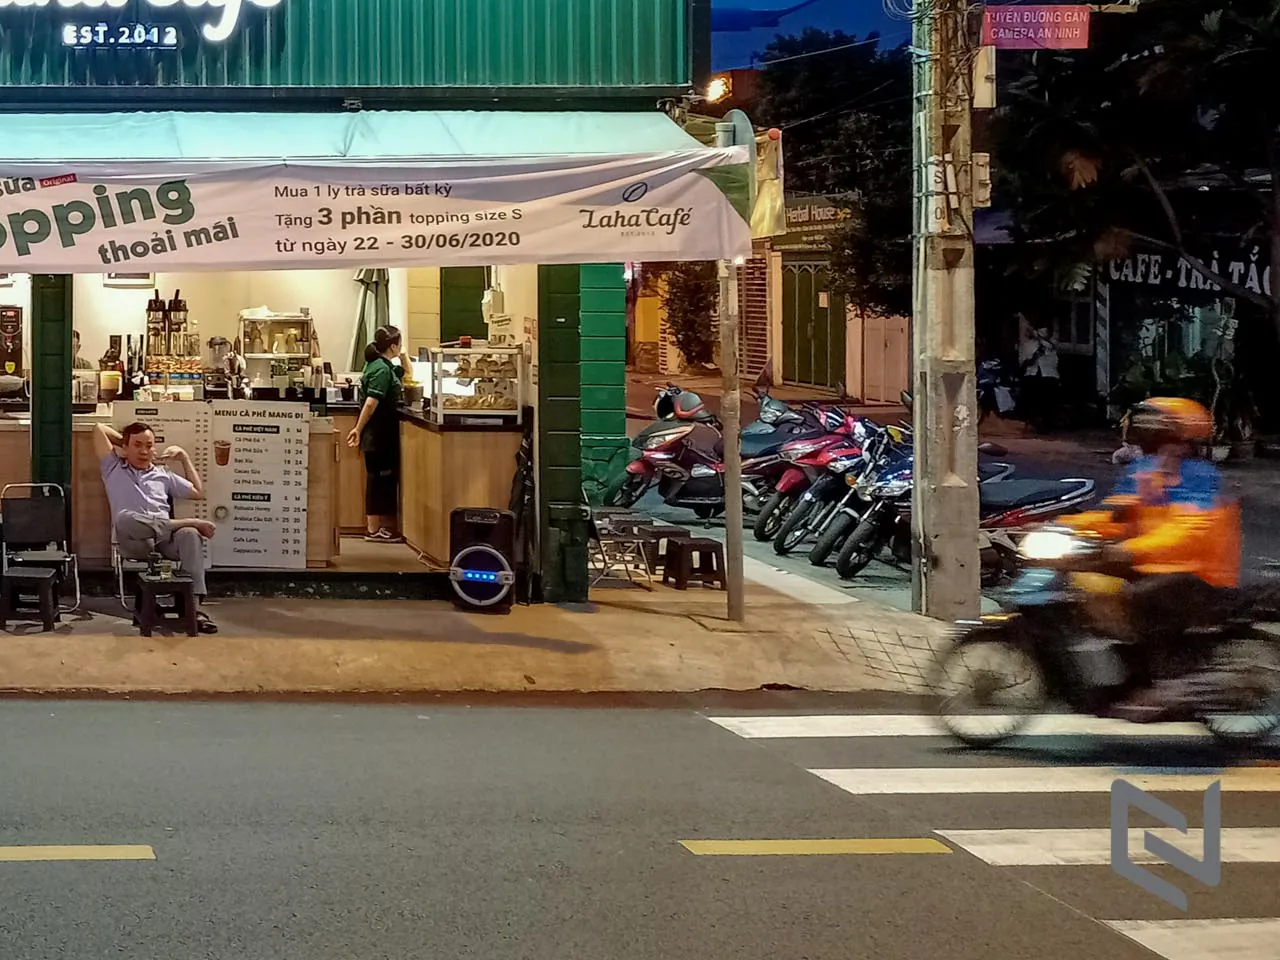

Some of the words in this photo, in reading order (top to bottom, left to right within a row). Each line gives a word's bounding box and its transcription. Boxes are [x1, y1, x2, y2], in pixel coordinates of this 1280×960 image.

[61, 23, 178, 45] EST.2012
[991, 28, 1035, 39] CAMERA
[1036, 28, 1053, 39] AN
[1054, 28, 1081, 39] NINH
[43, 175, 75, 187] Original
[274, 185, 308, 198] Mua
[314, 185, 321, 197] 1
[327, 184, 340, 199] ly
[345, 184, 366, 197] trà
[370, 183, 400, 196] sữa
[404, 183, 431, 196] bất
[434, 183, 452, 198] kỳ
[275, 214, 312, 229] Tặng
[317, 208, 333, 225] 3
[341, 205, 402, 229] phần
[409, 212, 470, 224] topping
[475, 210, 507, 221] size
[512, 208, 522, 220] S
[579, 207, 641, 228] Laha
[640, 207, 693, 235] Café
[811, 205, 837, 220] House
[98, 229, 178, 264] thoải
[183, 216, 239, 249] mái
[275, 238, 296, 253] từ
[302, 238, 347, 255] ngày
[353, 236, 380, 251] 22
[401, 231, 521, 249] 30/06/2020
[1109, 253, 1162, 284] CAFE
[239, 409, 250, 417] CÀ
[252, 409, 267, 417] PHÊ
